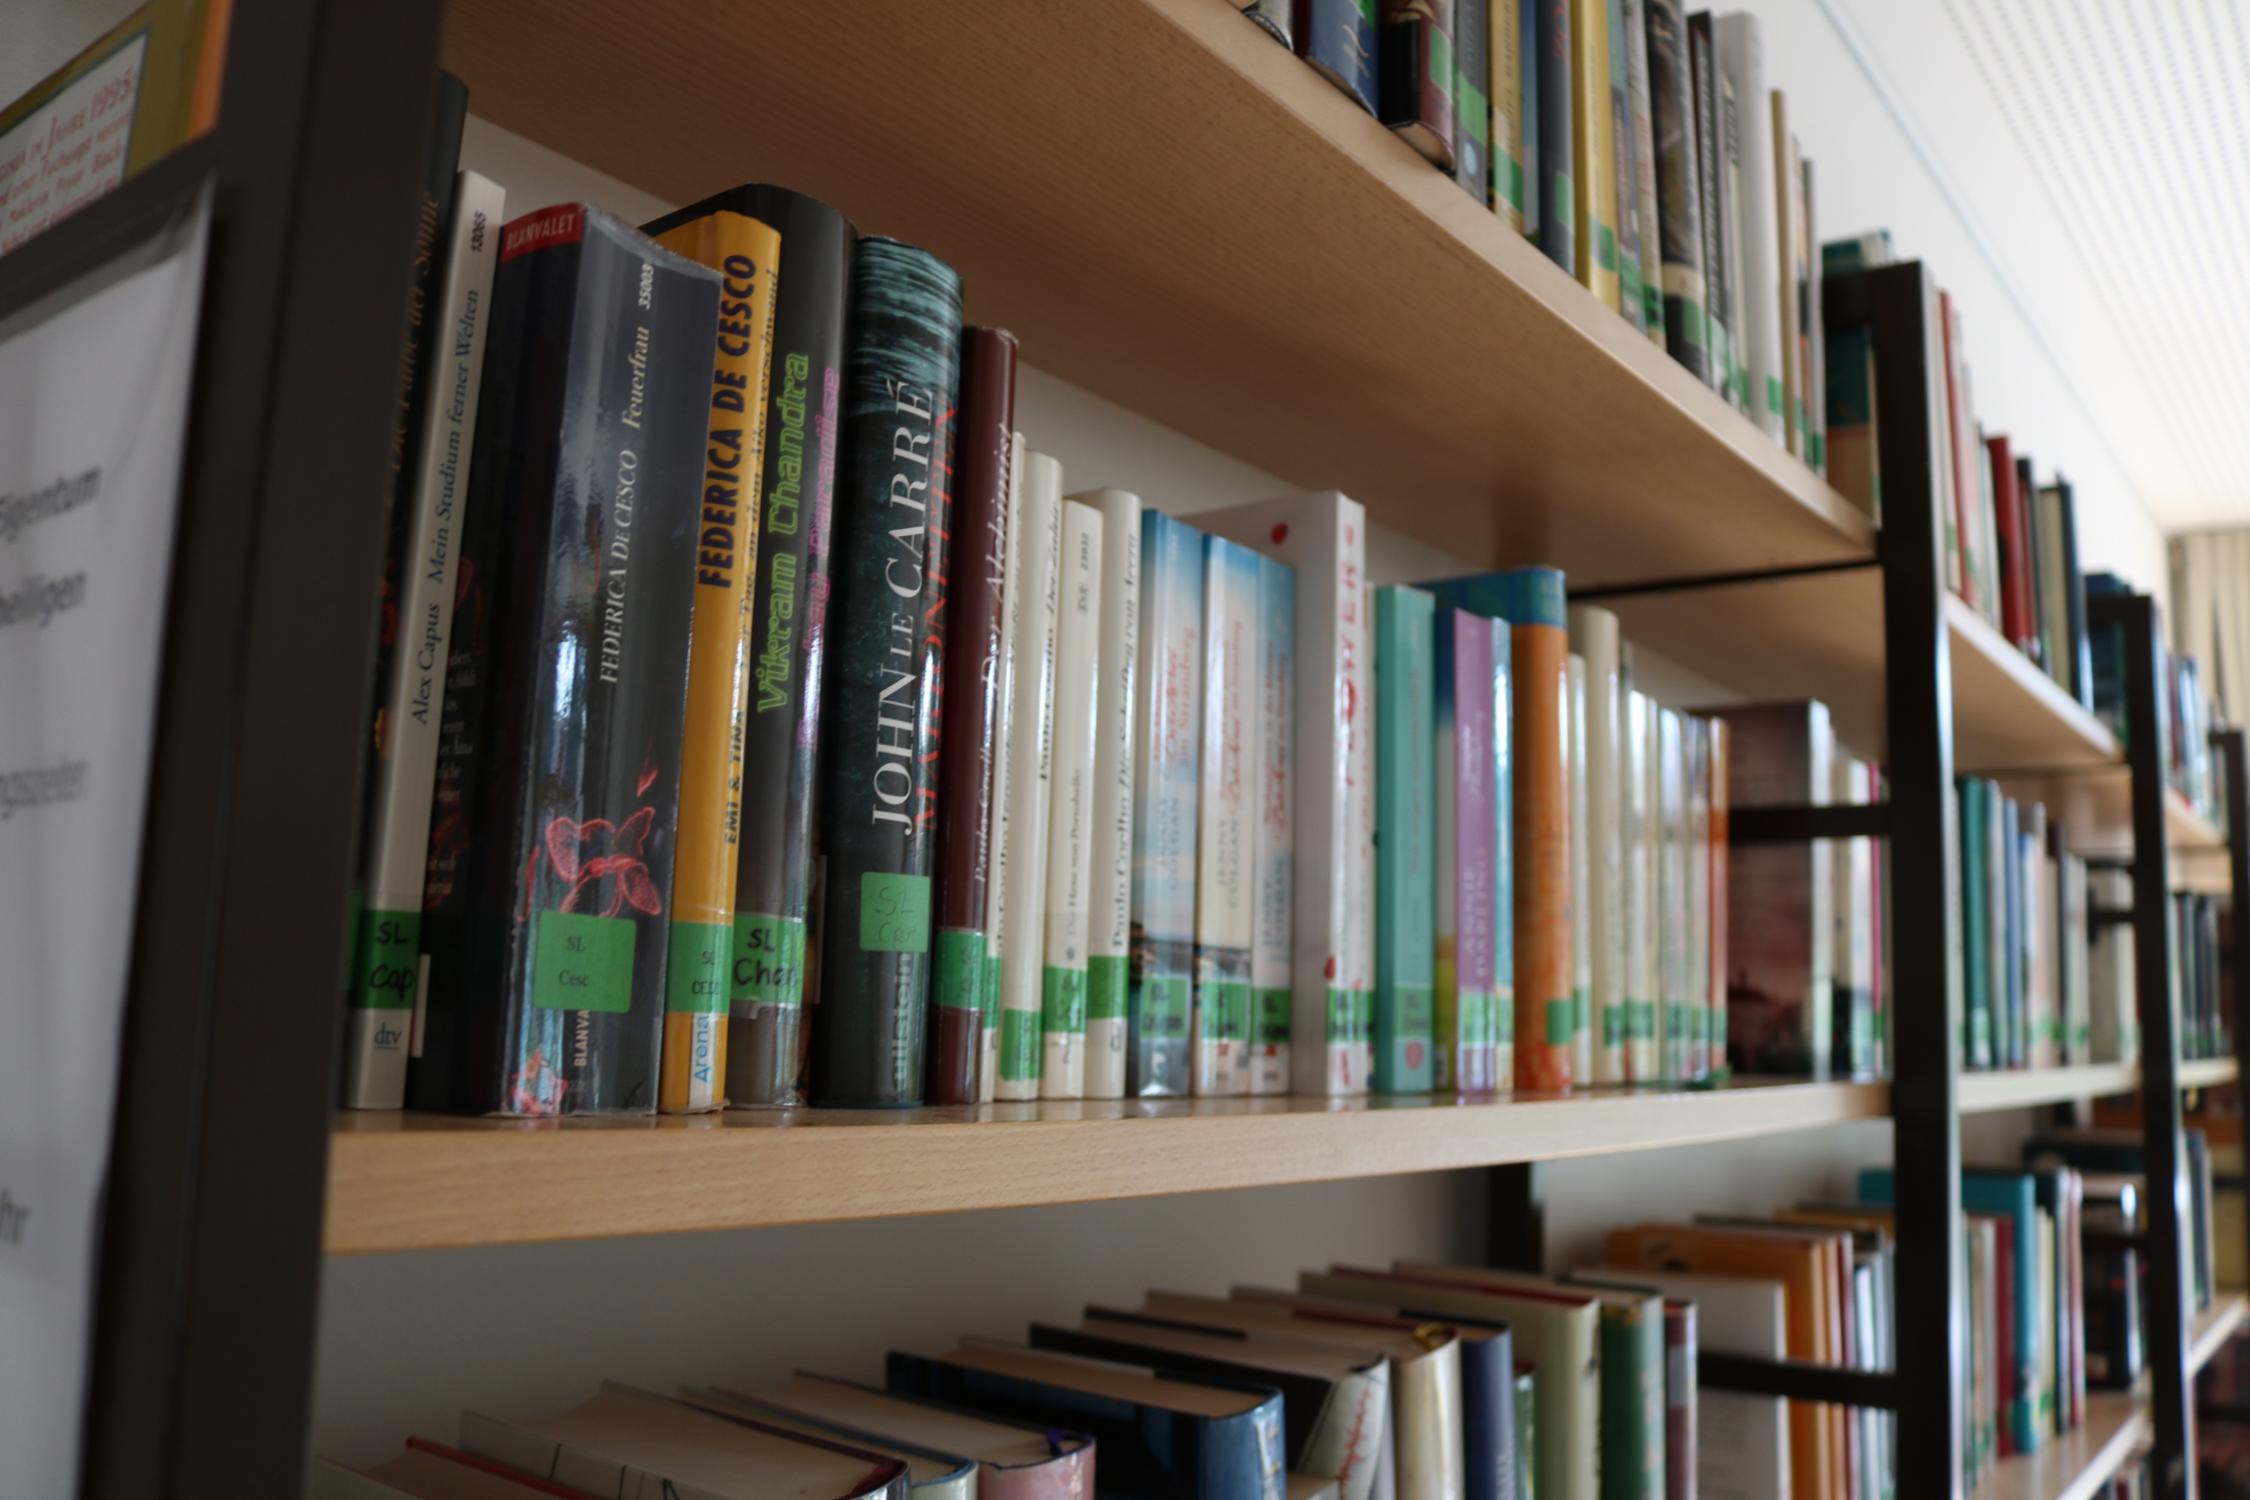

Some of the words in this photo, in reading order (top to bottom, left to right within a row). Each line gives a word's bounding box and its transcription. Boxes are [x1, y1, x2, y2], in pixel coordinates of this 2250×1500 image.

[505, 213, 576, 252] BLANVALET
[637, 263, 655, 310] 35003
[718, 255, 755, 355] CESCO
[456, 290, 479, 357] Welten
[446, 363, 469, 425] ferner
[622, 325, 651, 431] Feuerfrau
[713, 368, 748, 414] DE
[767, 352, 810, 537] Chandra
[807, 367, 840, 559] Paradise
[436, 432, 461, 521] Studium
[613, 449, 639, 527] CESCO
[747, 473, 760, 523] dem
[886, 377, 933, 599] CARRÉ
[699, 427, 742, 589] FEDERICA
[986, 423, 1011, 601] Alchimist
[428, 527, 445, 584] Mein
[417, 602, 441, 671] Capus
[600, 570, 629, 683] FEDERICA
[757, 553, 795, 713] Vikram
[891, 612, 913, 657] LE
[412, 677, 431, 726] Alex
[872, 663, 917, 836] JOHN
[729, 775, 740, 792] &
[725, 802, 738, 844] EMI
[875, 886, 915, 916] SL
[376, 922, 409, 945] SL
[566, 936, 585, 952] SL
[747, 928, 775, 952] SL
[369, 965, 415, 1001] Cap
[558, 969, 590, 988] Cesc
[374, 1021, 401, 1047] dtv
